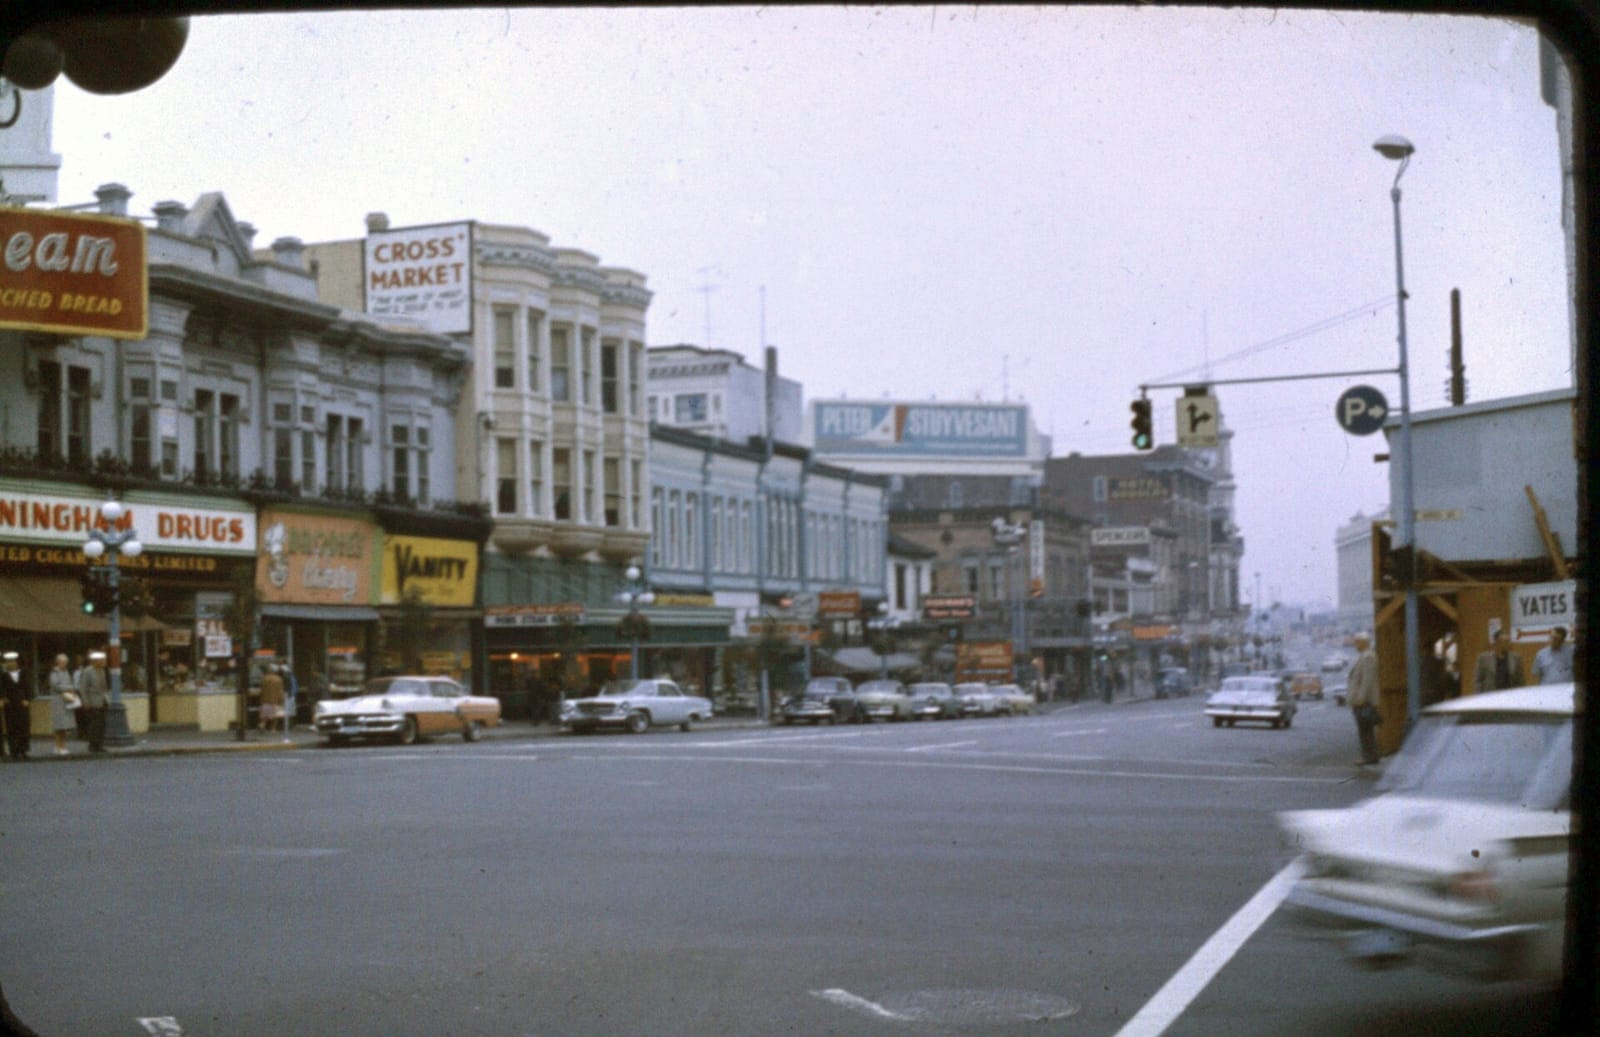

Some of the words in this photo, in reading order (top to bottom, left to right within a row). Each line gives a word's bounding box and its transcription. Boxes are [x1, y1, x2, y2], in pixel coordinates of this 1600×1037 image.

[4, 231, 118, 277] eam
[371, 262, 464, 290] MARKET
[0, 289, 53, 310] CHED
[60, 292, 123, 315] BREAD
[821, 406, 872, 434] PETER
[907, 407, 1018, 437] STUYVESANT
[1345, 397, 1366, 426] P
[158, 512, 244, 543] DRUGS
[36, 549, 86, 565] CIGAR
[154, 557, 217, 571] LIMITED
[395, 543, 468, 595] VANITY
[1519, 593, 1567, 616] YATES
